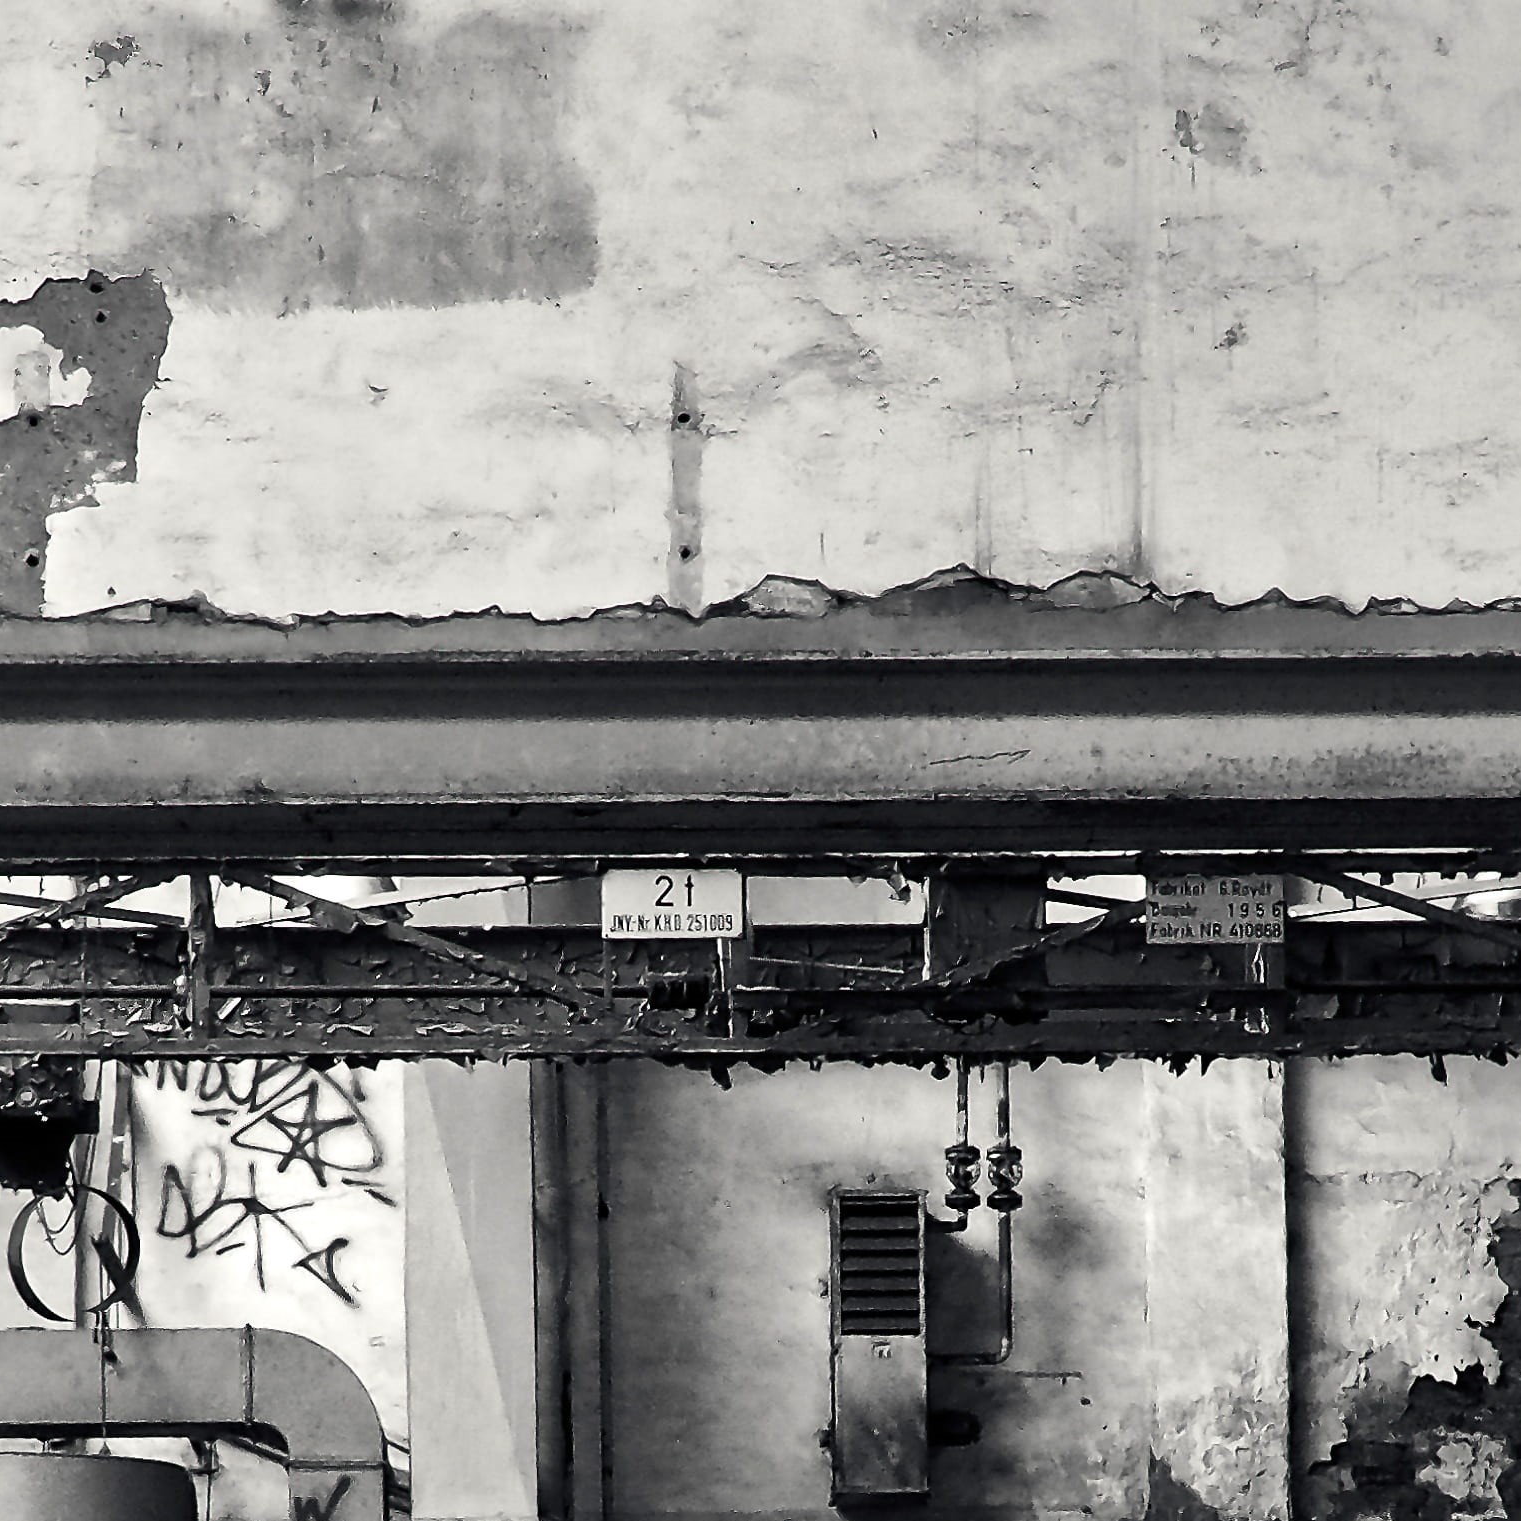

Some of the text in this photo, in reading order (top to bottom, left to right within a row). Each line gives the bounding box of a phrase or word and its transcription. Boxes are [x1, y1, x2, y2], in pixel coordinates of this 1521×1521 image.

[654, 873, 695, 907] 2 t
[686, 914, 732, 932] 251009
[1150, 922, 1196, 938] Fabrik
